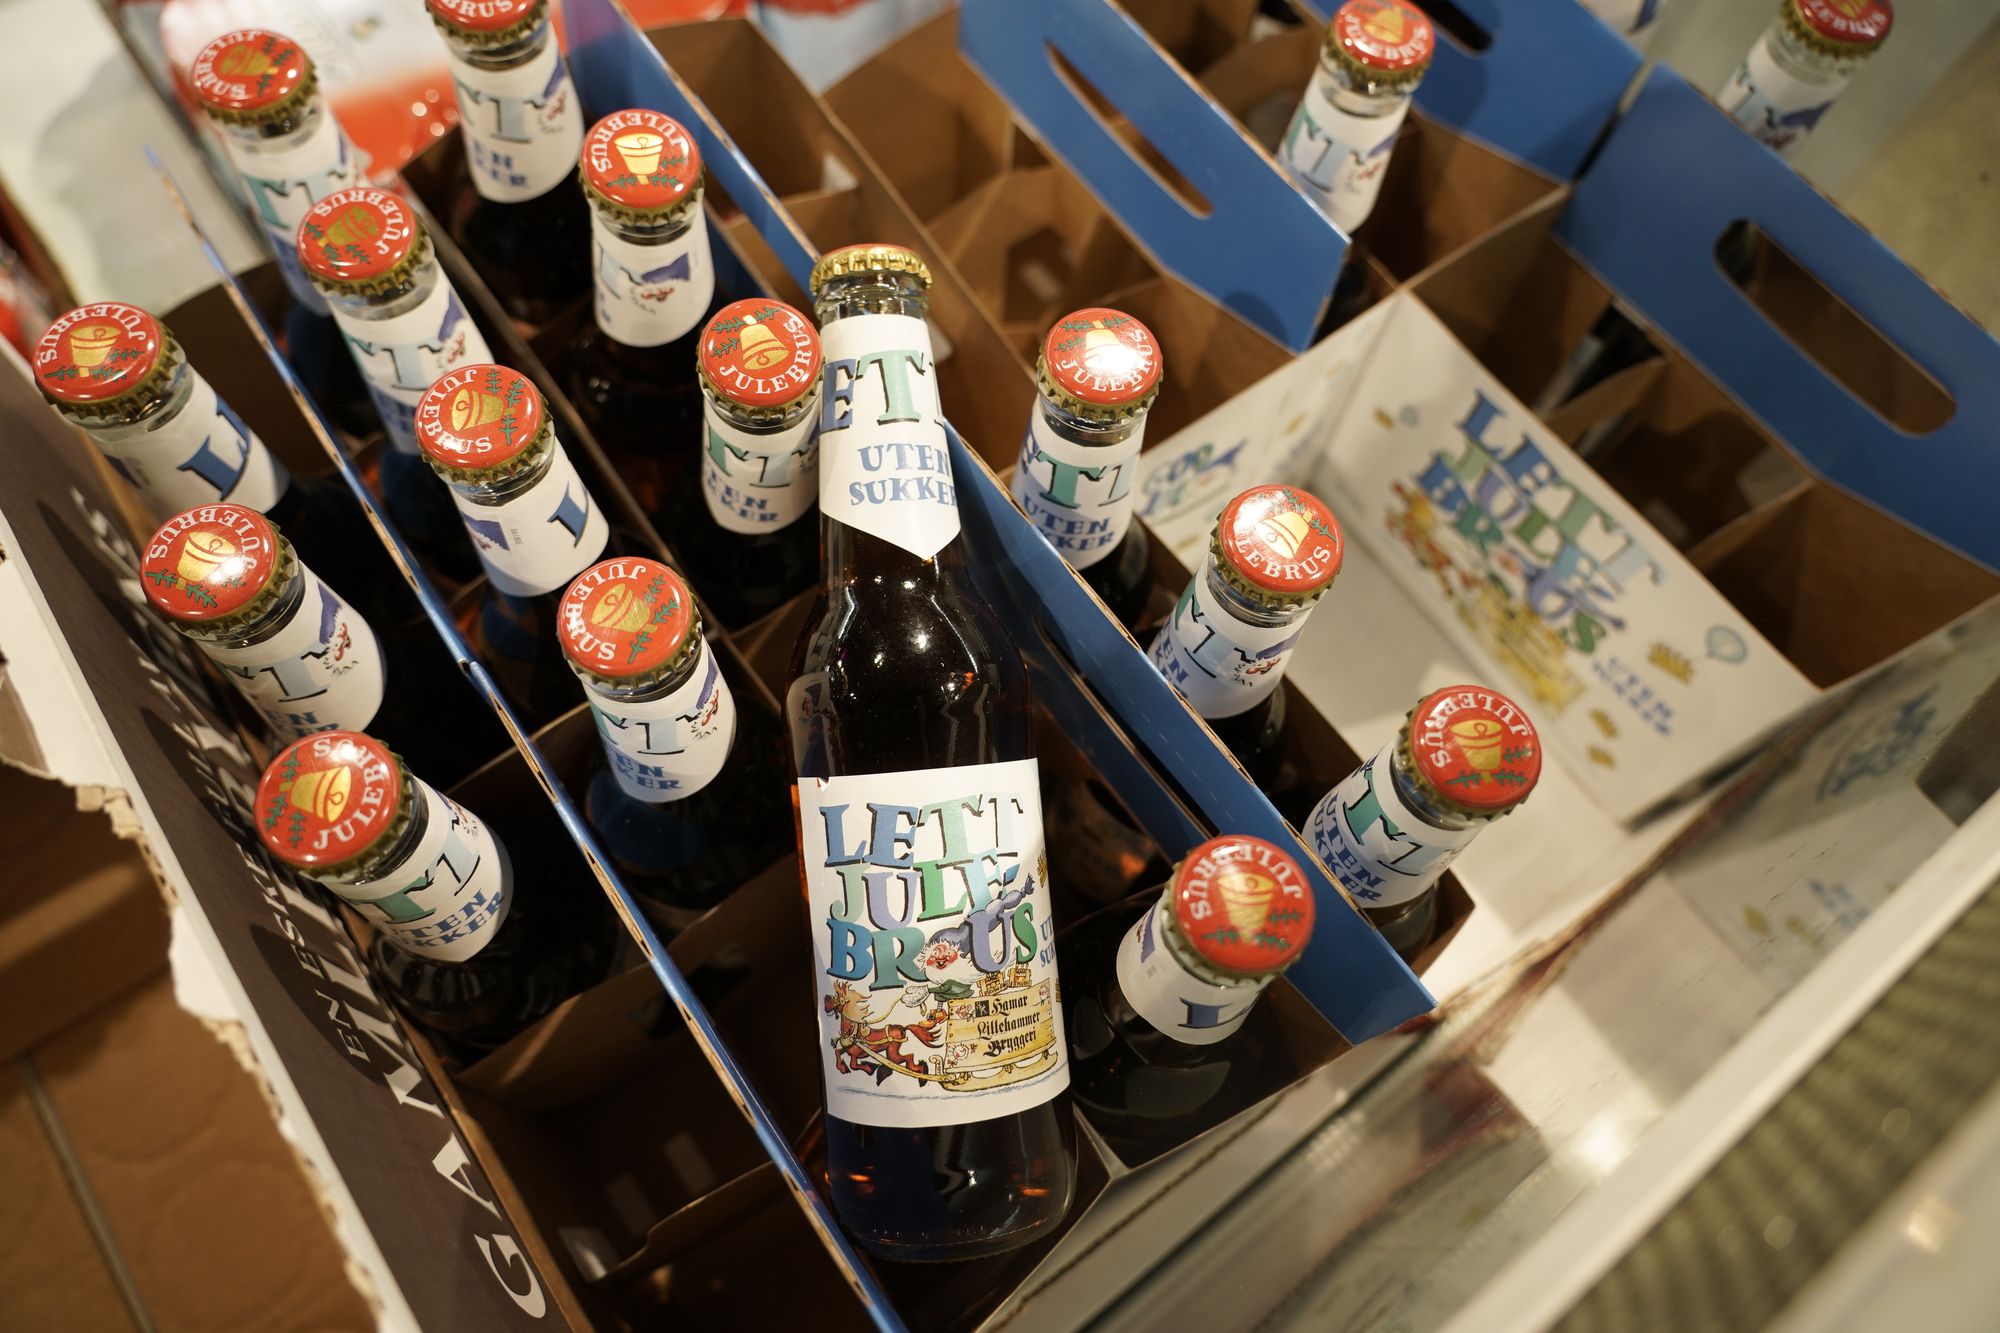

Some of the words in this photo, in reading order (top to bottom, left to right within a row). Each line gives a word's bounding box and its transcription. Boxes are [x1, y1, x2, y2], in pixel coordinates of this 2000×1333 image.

[591, 112, 688, 173] JULEBRUS
[314, 190, 404, 255] JULEBRUS
[40, 304, 147, 364] JULEBRUS
[720, 314, 812, 395] JULEBRUS
[1060, 328, 1154, 393] JULEBRUS
[423, 369, 493, 454] JULEBRUS
[857, 443, 950, 474] UTEN
[1455, 388, 1666, 594] LETT
[150, 508, 261, 571] JULEBRUS
[566, 563, 648, 661] JULEBRUS
[1425, 692, 1533, 768] JULEBRUS
[819, 793, 1025, 869] LETT
[1326, 792, 1386, 889] UTEN
[829, 848, 1022, 931] JULE
[1187, 841, 1304, 921] JULEBRUS
[826, 902, 1038, 991] BRUS
[313, 988, 371, 1063] EN
[976, 1012, 1042, 1040] Lillehammer
[991, 994, 1029, 1016] Hamar
[982, 1030, 1038, 1058] Bryggeri
